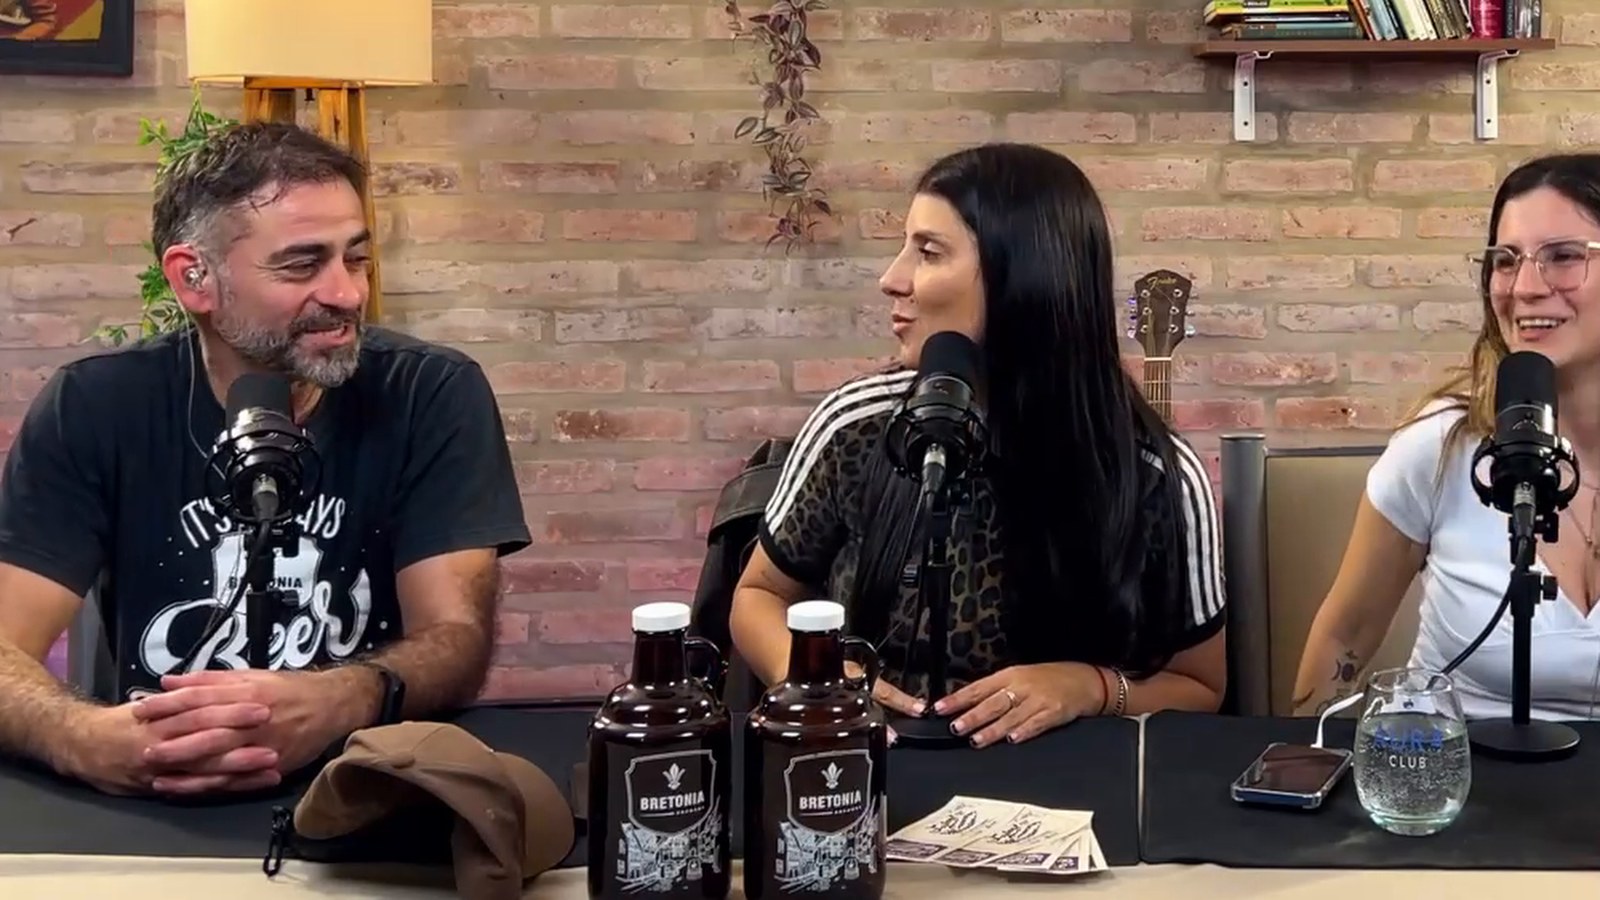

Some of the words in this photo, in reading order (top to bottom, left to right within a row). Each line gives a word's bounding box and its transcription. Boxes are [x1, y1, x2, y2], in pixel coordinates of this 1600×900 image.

[1388, 755, 1427, 769] CLUB
[640, 790, 705, 811] BRETONIA
[799, 789, 862, 810] BRETONIA
